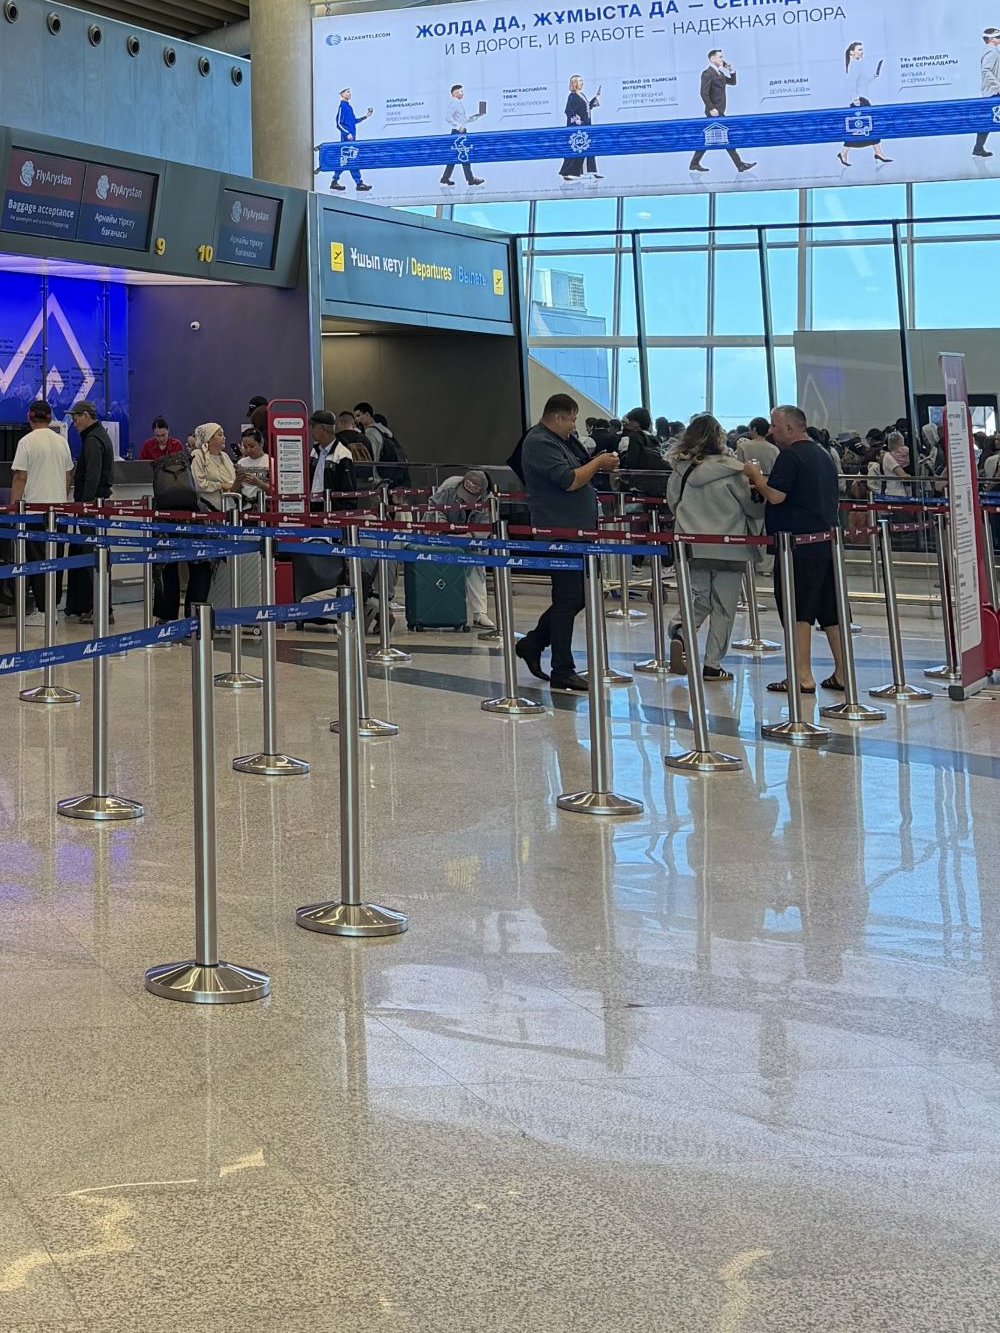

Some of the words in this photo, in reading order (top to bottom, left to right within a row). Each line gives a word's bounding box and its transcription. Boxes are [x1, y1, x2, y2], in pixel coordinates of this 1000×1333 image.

[416, 17, 486, 39] ЖОЛДА
[492, 14, 526, 34] ДА,
[533, 3, 642, 27] ЖҰМЫСТА
[649, 0, 679, 18] ДА
[344, 32, 390, 41] KAZAKHTELECOM
[444, 42, 455, 55] И
[460, 41, 470, 54] В
[476, 34, 542, 55] ДОРОГЕ,
[548, 32, 558, 45] И
[566, 30, 575, 44] В
[582, 25, 645, 43] РАБОТЕ
[673, 12, 776, 36] НАДЕЖНАЯ
[782, 6, 846, 25] ОПОРА
[36, 170, 72, 186] FlyArystan
[110, 182, 142, 198] FlyArystan
[8, 198, 36, 214] Baggage
[38, 205, 74, 218] acceptance
[242, 207, 269, 222] FlyArystan
[156, 238, 166, 256] 9
[198, 244, 214, 263] 10
[350, 247, 380, 270] Ұшып
[382, 257, 404, 278] кету
[406, 257, 409, 274] /
[411, 257, 452, 281] Departures
[416, 553, 432, 561] ALA
[256, 610, 269, 619] ALA
[323, 603, 335, 612] ALA
[158, 627, 171, 638] ALA
[83, 642, 98, 655] ALA
